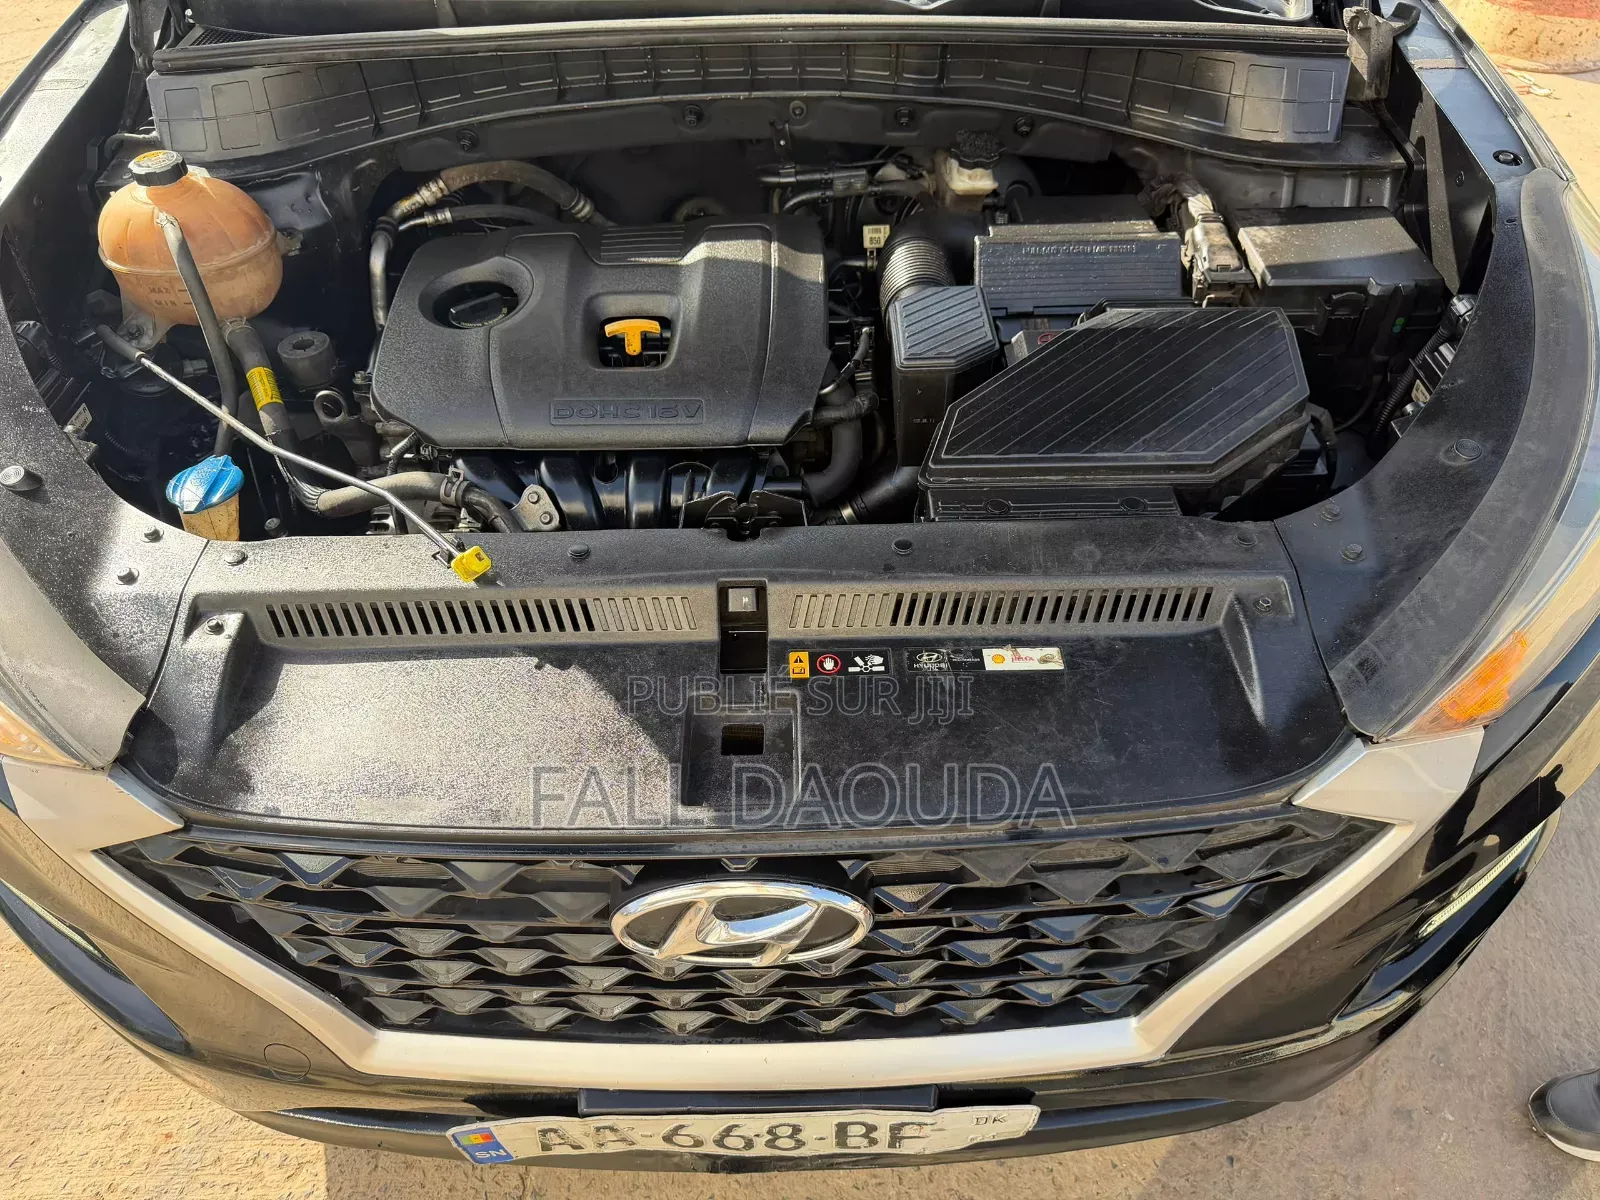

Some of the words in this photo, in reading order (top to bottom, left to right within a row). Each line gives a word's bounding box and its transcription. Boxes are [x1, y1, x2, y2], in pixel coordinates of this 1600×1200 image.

[551, 403, 641, 420] DOHC
[647, 403, 702, 419] 16V
[973, 1114, 1008, 1126] DK
[537, 1120, 938, 1152] AA-668-BF
[474, 1148, 508, 1159] SN
